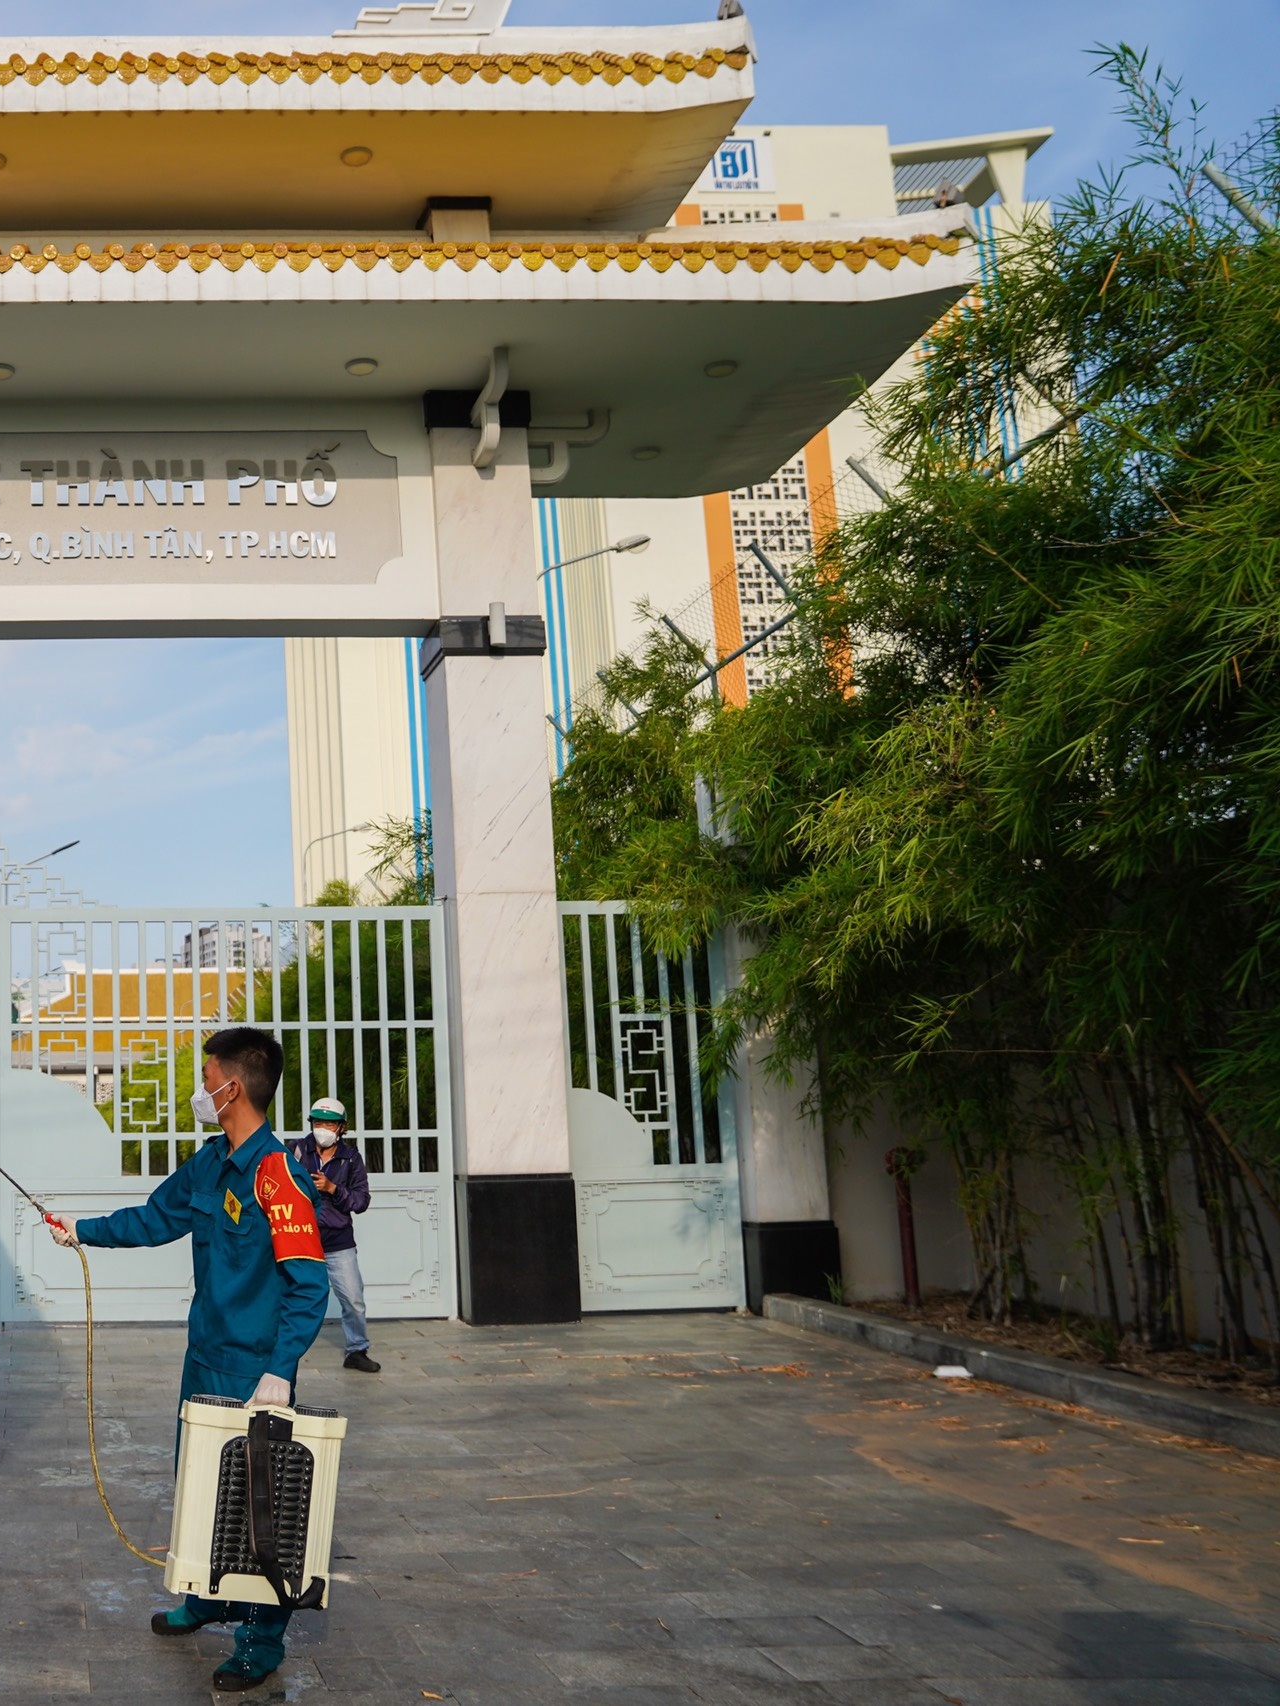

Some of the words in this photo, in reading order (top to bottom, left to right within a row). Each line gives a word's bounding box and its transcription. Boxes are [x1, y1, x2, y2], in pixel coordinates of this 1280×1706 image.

[20, 449, 206, 506] THÀNH
[226, 442, 341, 506] PHỐ
[28, 523, 134, 565] Q.BÌNH
[144, 525, 214, 564] TÂN,
[219, 530, 337, 558] TP.HCM
